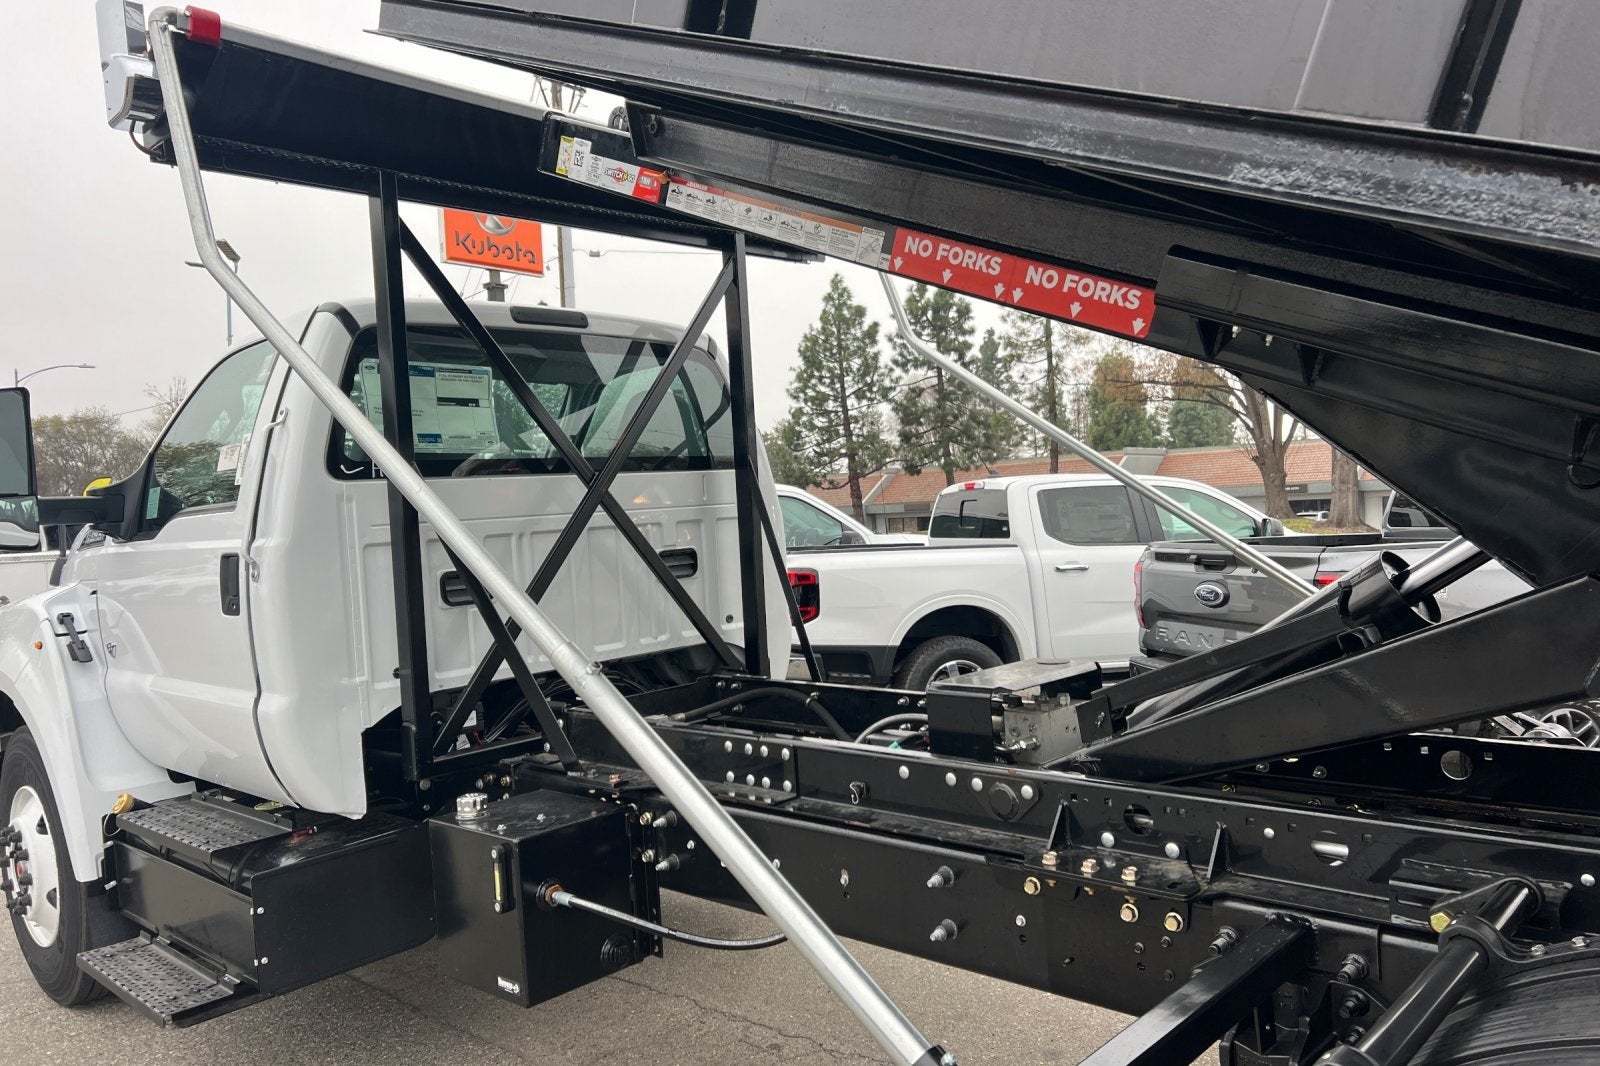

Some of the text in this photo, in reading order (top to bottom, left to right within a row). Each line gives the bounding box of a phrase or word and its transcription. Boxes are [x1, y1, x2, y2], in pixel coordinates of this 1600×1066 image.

[455, 230, 536, 265] Kubota
[904, 235, 1003, 276] NO FORKS
[1025, 264, 1142, 311] NO FORKS
